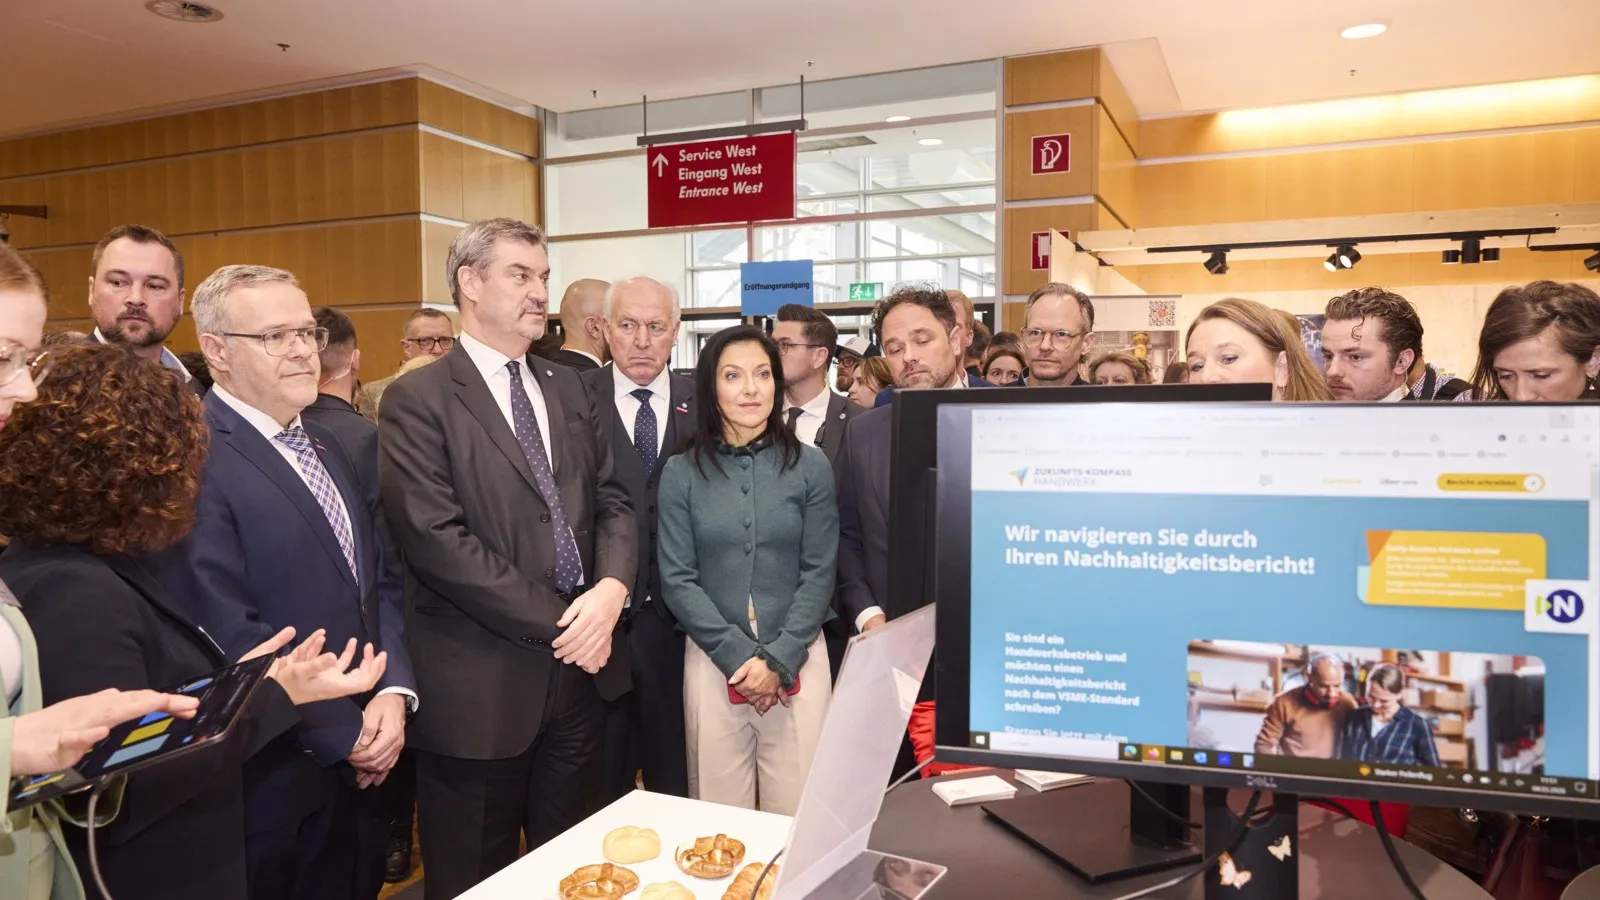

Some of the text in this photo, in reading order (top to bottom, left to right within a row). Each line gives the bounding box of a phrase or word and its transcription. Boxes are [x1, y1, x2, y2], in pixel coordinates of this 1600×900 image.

[679, 144, 757, 163] Service West
[678, 163, 762, 183] Eingang West
[678, 181, 763, 199] Entrance West
[744, 281, 810, 292] Eröffnungsrundgang
[1033, 476, 1097, 486] HANDWERK
[1004, 524, 1258, 549] Wir navigieren Sie durch
[1004, 548, 1315, 576] Ihren Nachhaltigkeitsbericht!
[1005, 632, 1064, 646] Sie sind ein
[1004, 646, 1127, 663] Handwerksbetrieb und
[1004, 660, 1084, 674] möchten einen
[1004, 674, 1127, 691] Nachhaltigkeitsbericht
[1004, 688, 1140, 707] nach dem VSME-Standard
[1004, 702, 1061, 714] schreiben?
